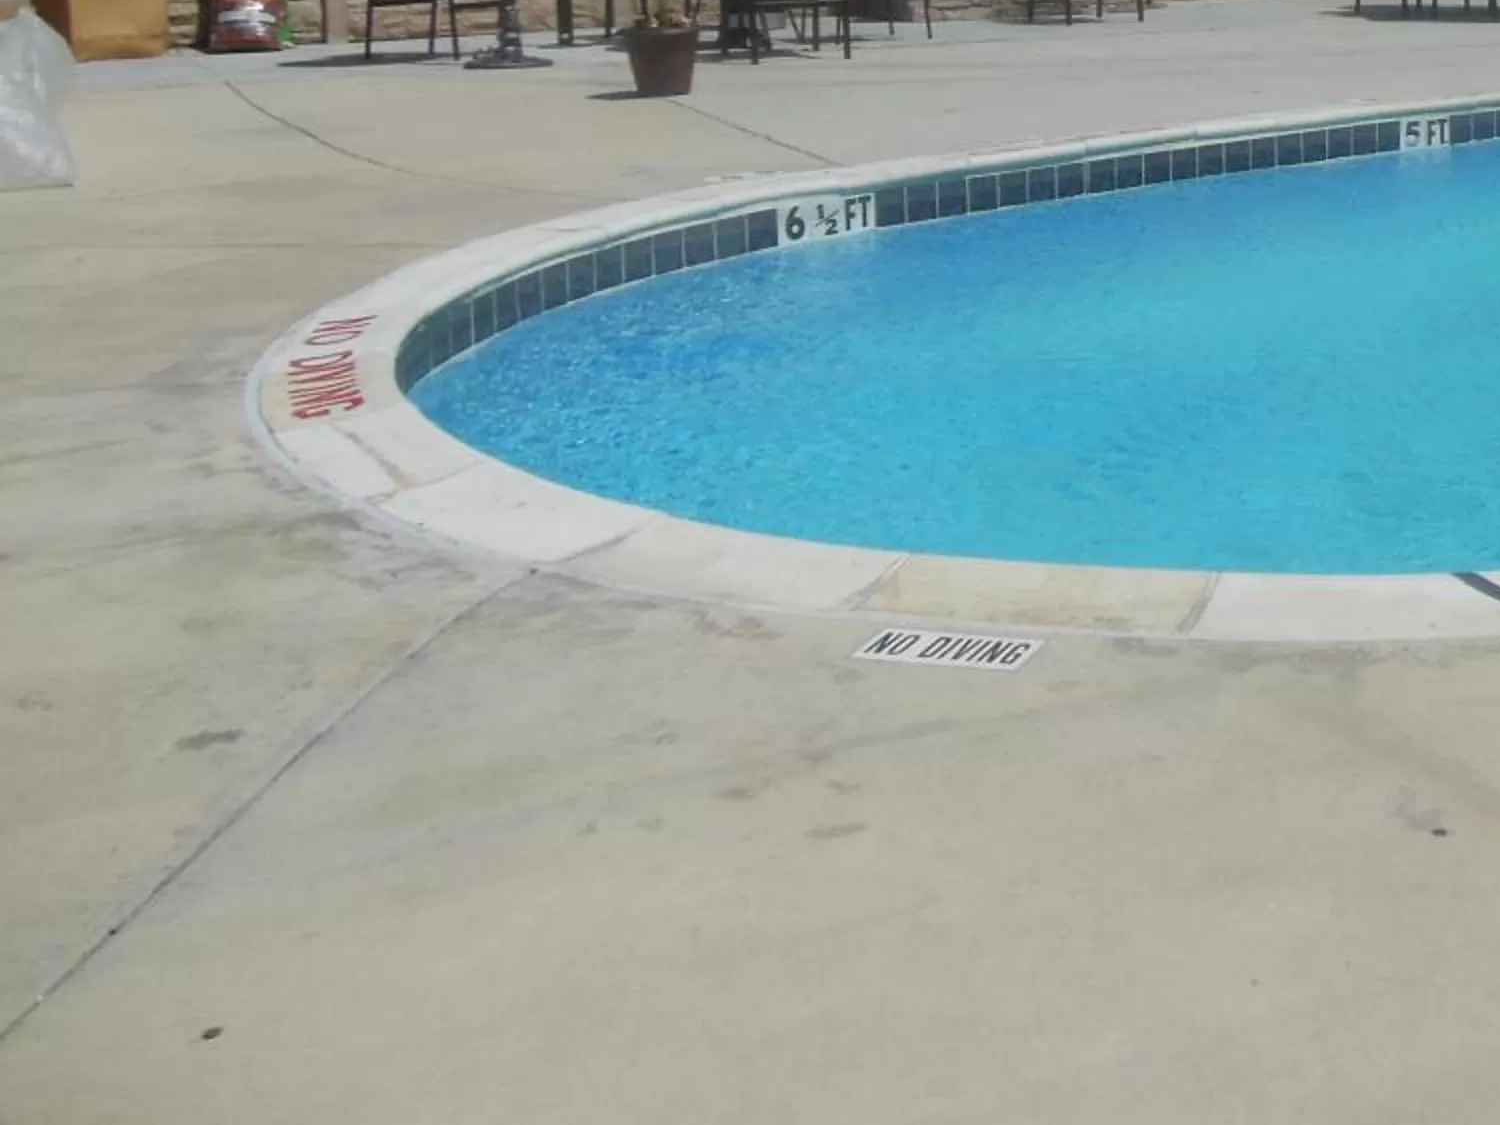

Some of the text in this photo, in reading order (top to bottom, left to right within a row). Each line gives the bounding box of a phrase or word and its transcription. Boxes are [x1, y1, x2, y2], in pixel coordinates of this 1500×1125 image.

[785, 205, 806, 241] 6
[844, 194, 872, 232] FT
[286, 314, 380, 420] NO DIVING
[863, 631, 1032, 666] NO DIVING
